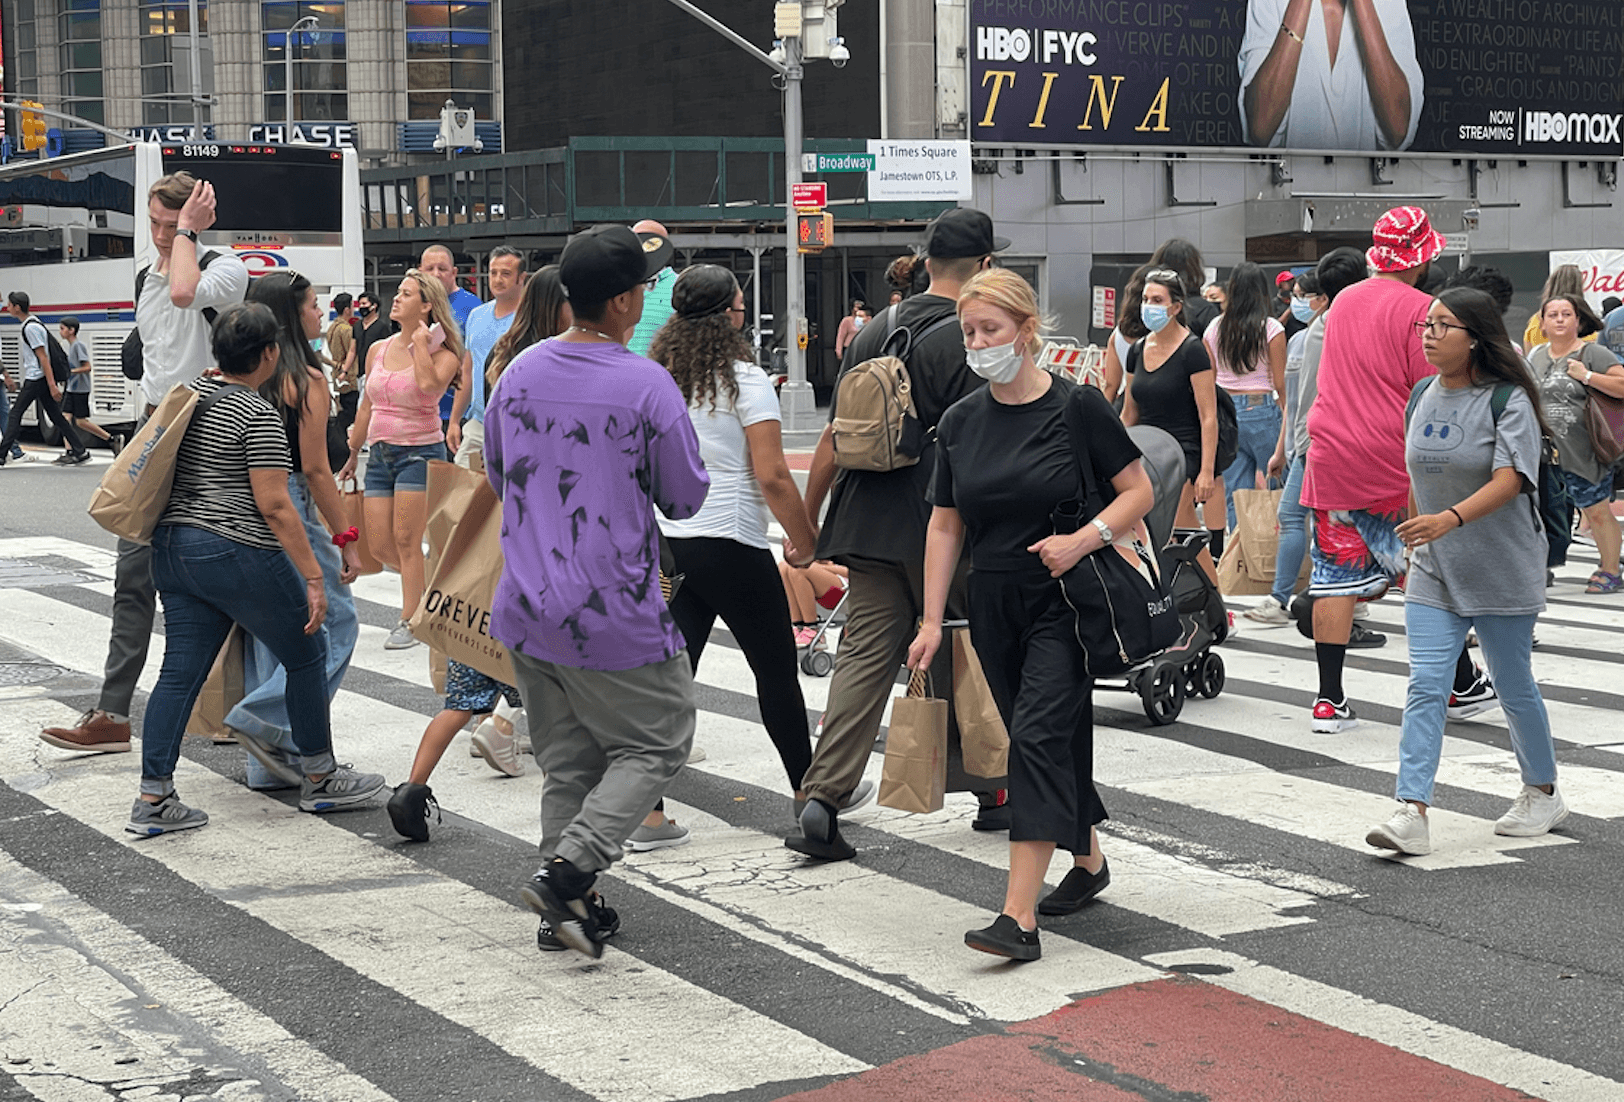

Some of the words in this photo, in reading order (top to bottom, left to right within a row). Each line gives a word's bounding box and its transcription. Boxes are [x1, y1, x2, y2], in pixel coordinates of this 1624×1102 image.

[1451, 0, 1514, 21] WEALTH
[1518, 1, 1539, 22] OF
[1542, 3, 1617, 28] ARCHIVAL
[976, 26, 1031, 62] HBO
[1043, 30, 1097, 66] FYC
[1114, 31, 1173, 57] VERVE
[1176, 33, 1218, 58] AND
[1443, 21, 1572, 49] EXTRAORDINARY
[1574, 30, 1601, 52] LIFE
[1175, 61, 1200, 86] OF
[977, 70, 1171, 131] TINA
[1547, 80, 1580, 102] AND
[1489, 110, 1515, 125] NOW
[249, 126, 352, 148] CHASE
[1459, 125, 1514, 141] STREAMING
[183, 144, 220, 157] 81149
[880, 146, 885, 157] 1
[888, 145, 919, 158] Times
[921, 145, 958, 160] Square
[819, 155, 873, 173] Broadway
[879, 171, 924, 182] Jamestown
[925, 171, 943, 182] OTS,
[944, 171, 958, 182] L.P.
[425, 590, 492, 636] OREVE
